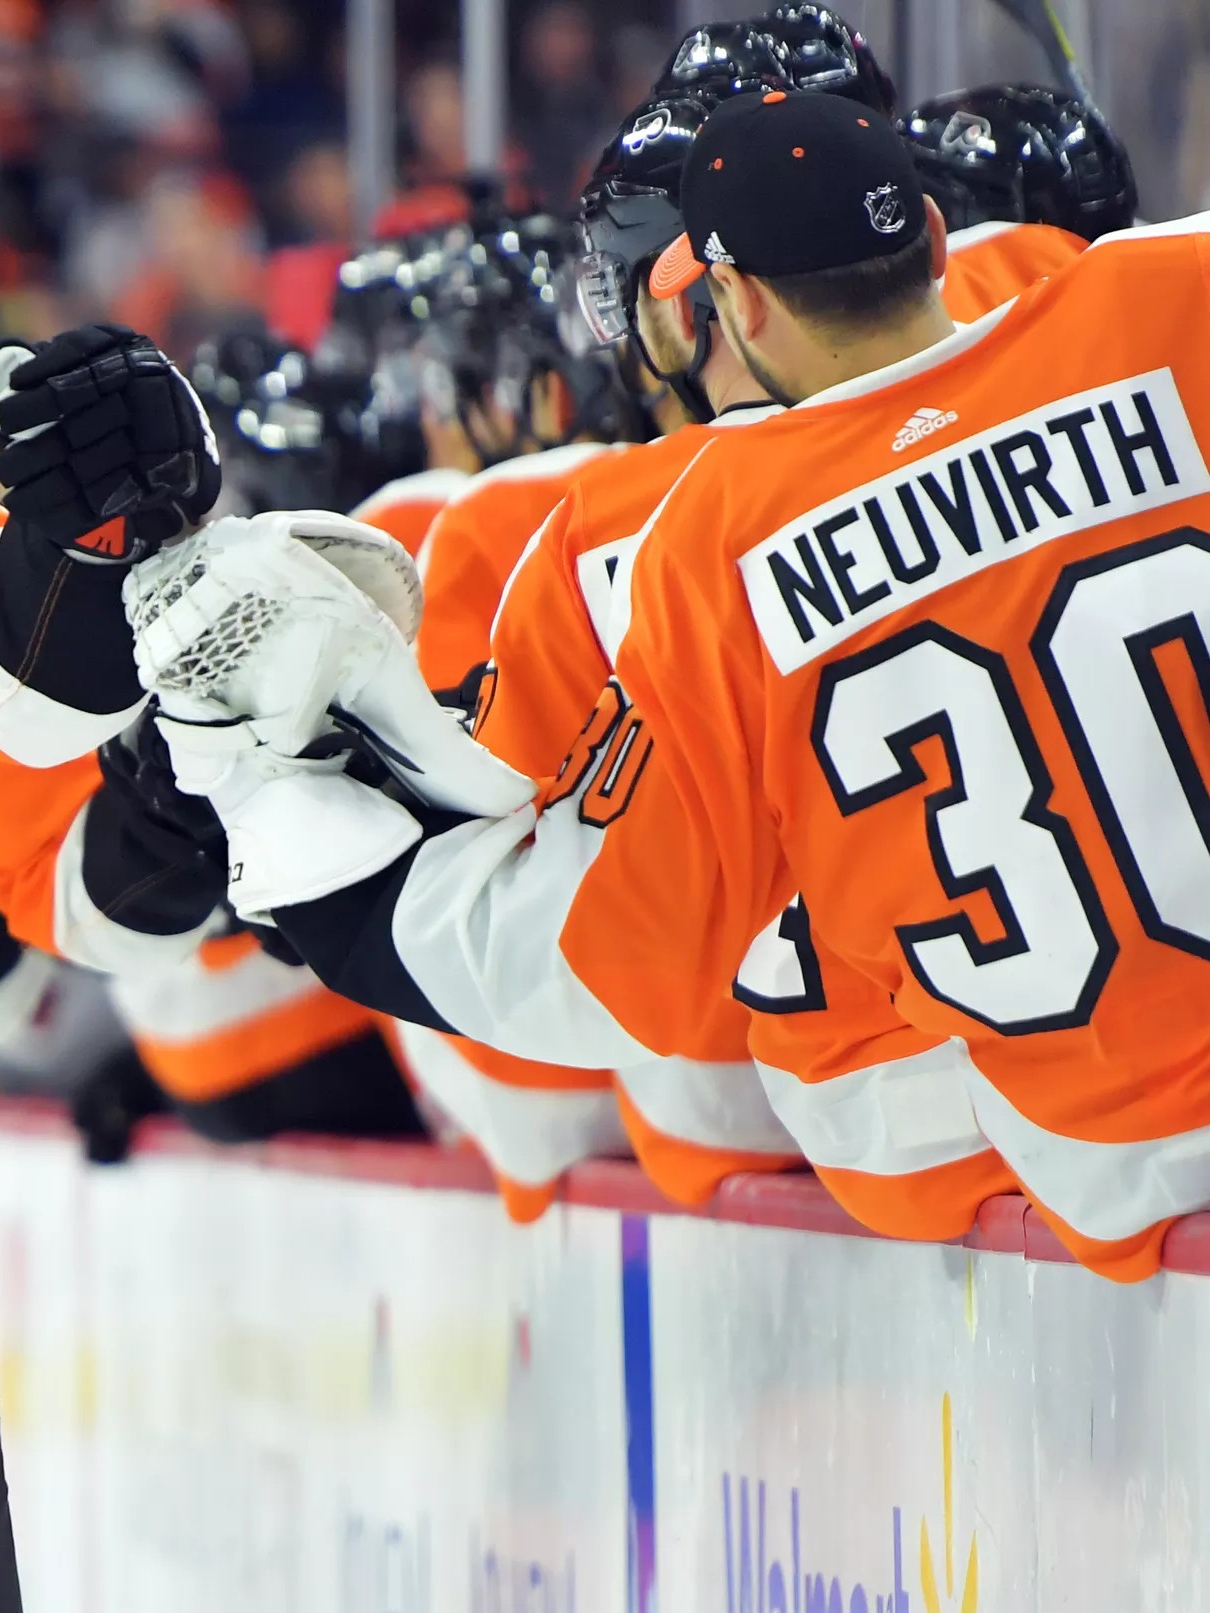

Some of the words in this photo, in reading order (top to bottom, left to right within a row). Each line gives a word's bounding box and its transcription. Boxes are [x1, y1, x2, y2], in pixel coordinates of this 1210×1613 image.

[766, 391, 1179, 643] NEUVIRTH
[891, 410, 959, 452] adidas
[810, 525, 1210, 1036] 30
